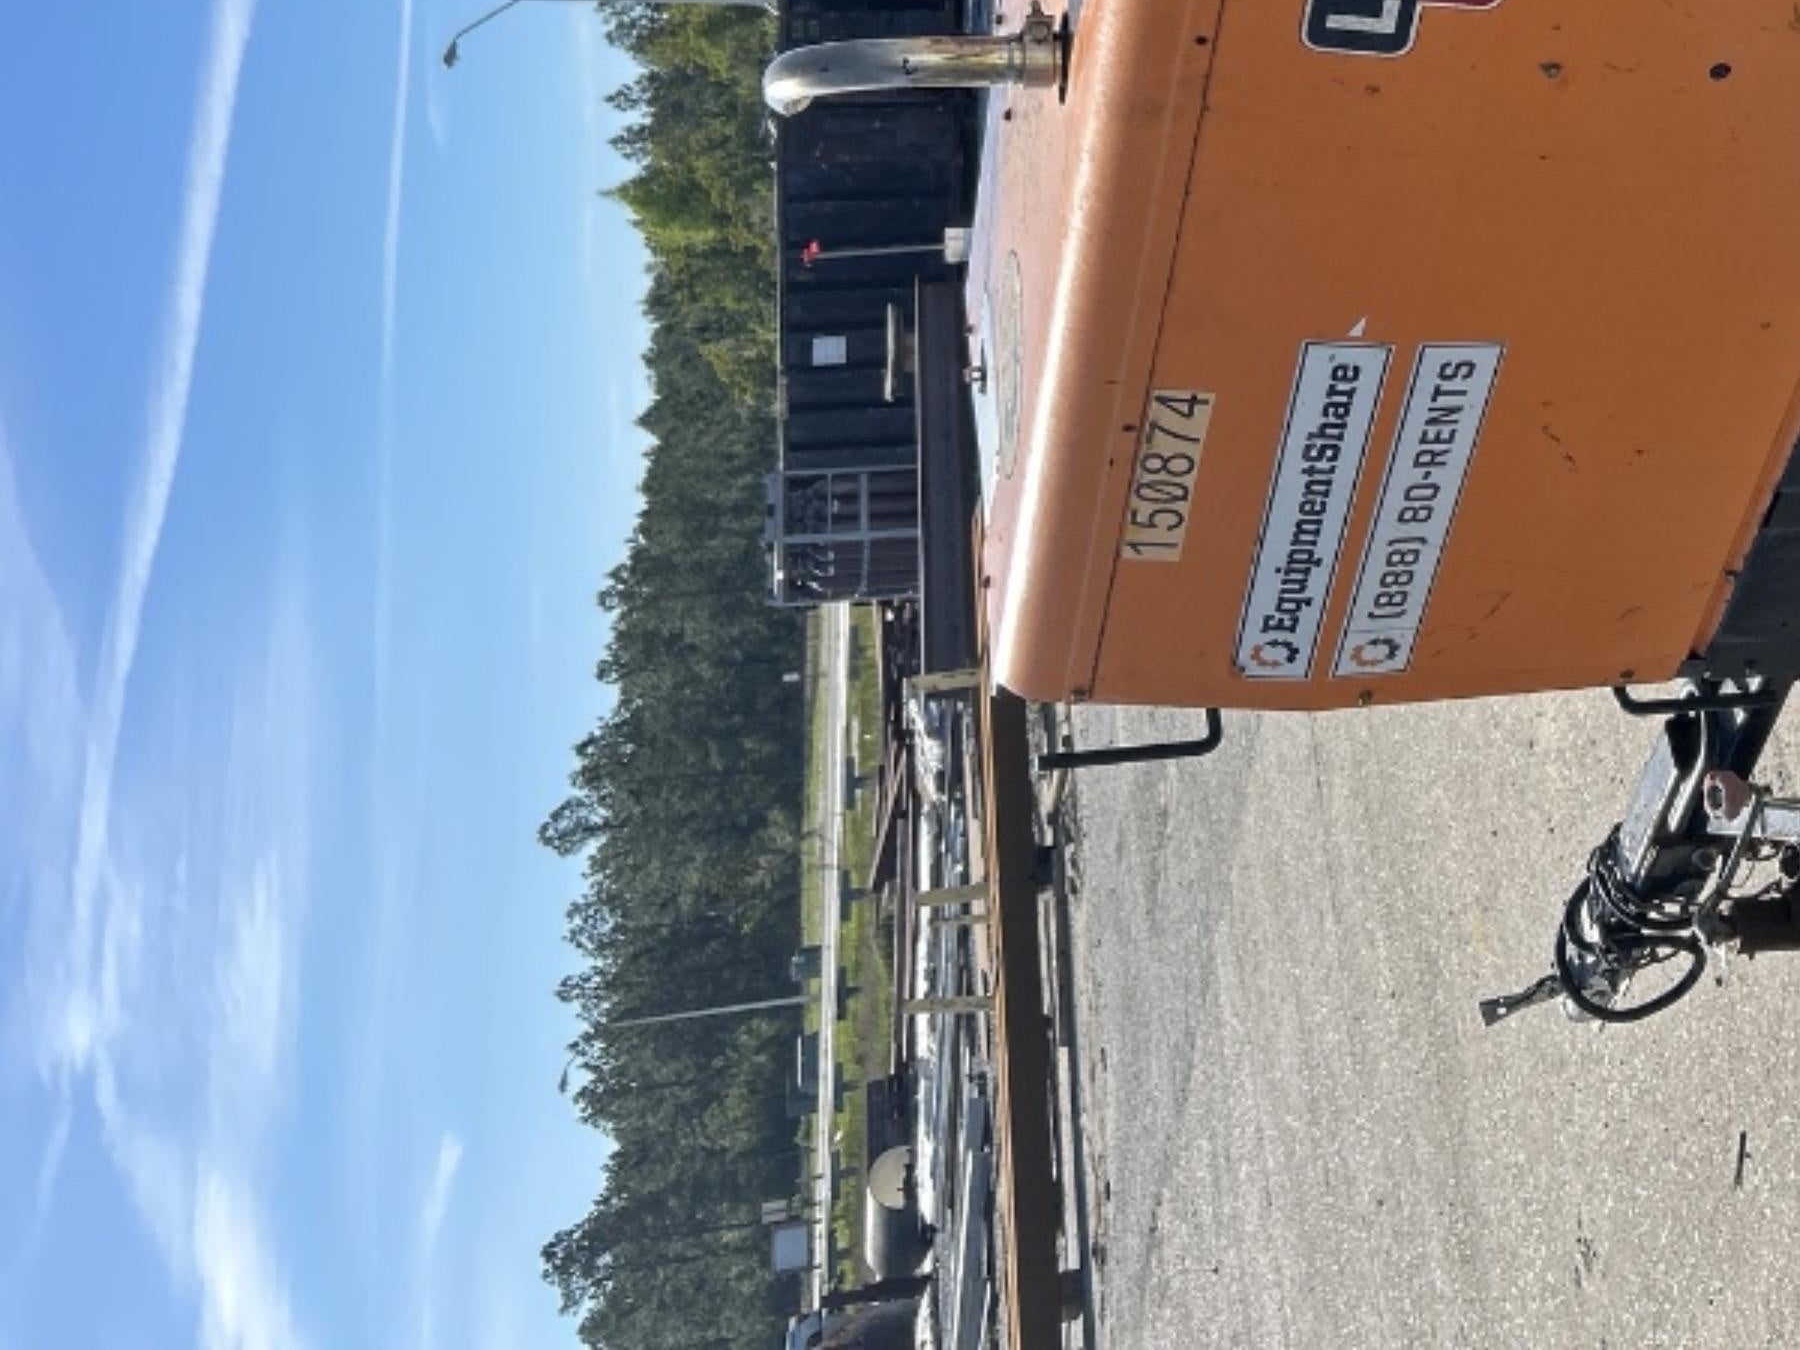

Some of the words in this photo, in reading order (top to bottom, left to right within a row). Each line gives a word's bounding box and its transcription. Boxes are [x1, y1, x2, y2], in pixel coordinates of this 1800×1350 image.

[1124, 393, 1210, 556] 150874
[1397, 360, 1477, 525] 80-RENTS
[1367, 536, 1429, 620] (888)
